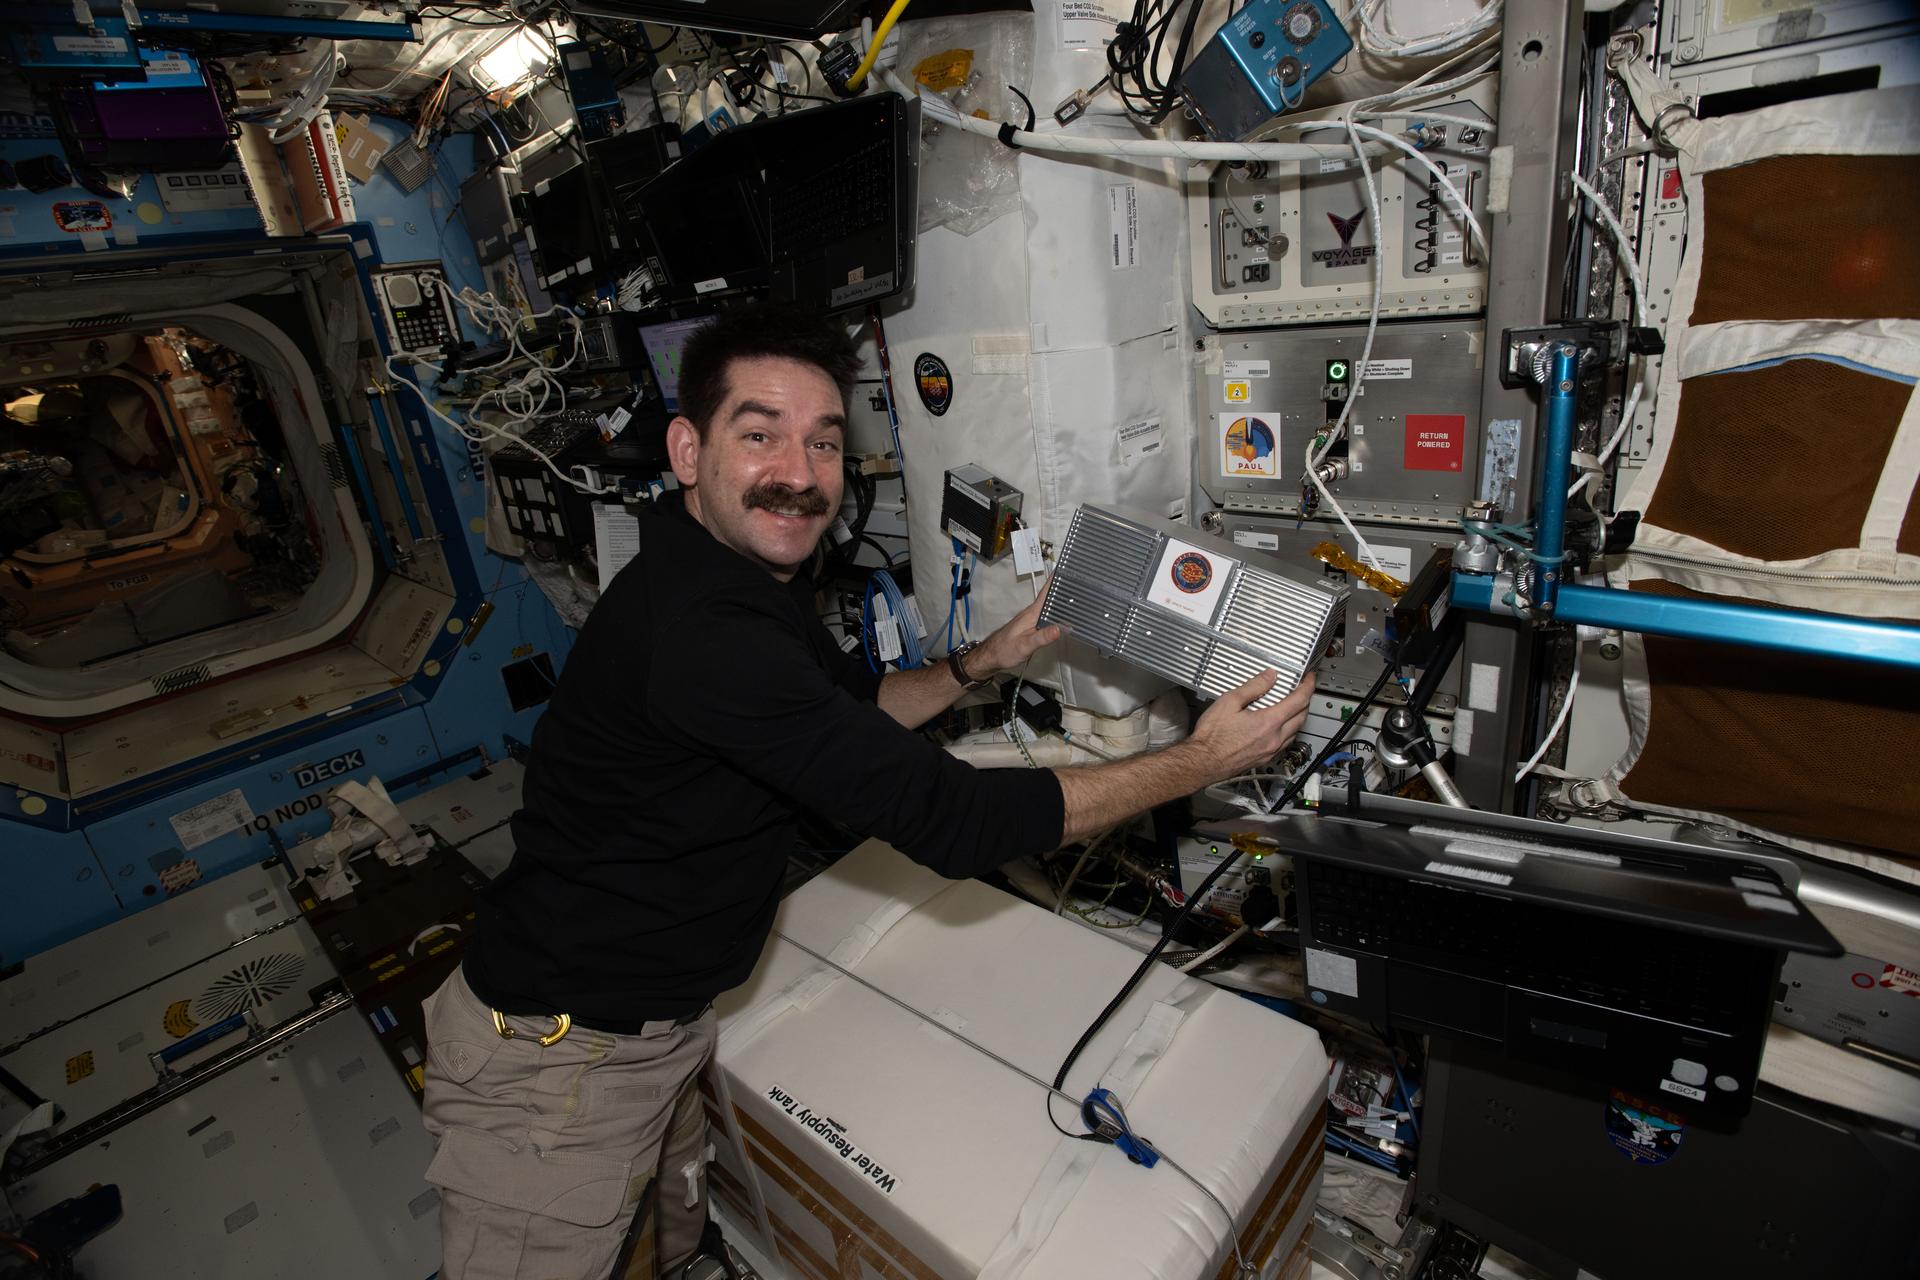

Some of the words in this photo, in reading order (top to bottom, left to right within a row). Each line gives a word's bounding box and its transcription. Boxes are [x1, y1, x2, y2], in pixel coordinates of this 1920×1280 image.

[305, 135, 328, 199] WARNING
[1327, 258, 1366, 268] SPACE
[1417, 441, 1451, 449] POWERED
[1420, 432, 1449, 440] RETURN
[298, 751, 363, 787] DECK
[769, 1086, 799, 1115] Tank
[1668, 1083, 1698, 1097] SSC4
[796, 1109, 855, 1158] Resupply
[851, 1153, 896, 1193] Water
